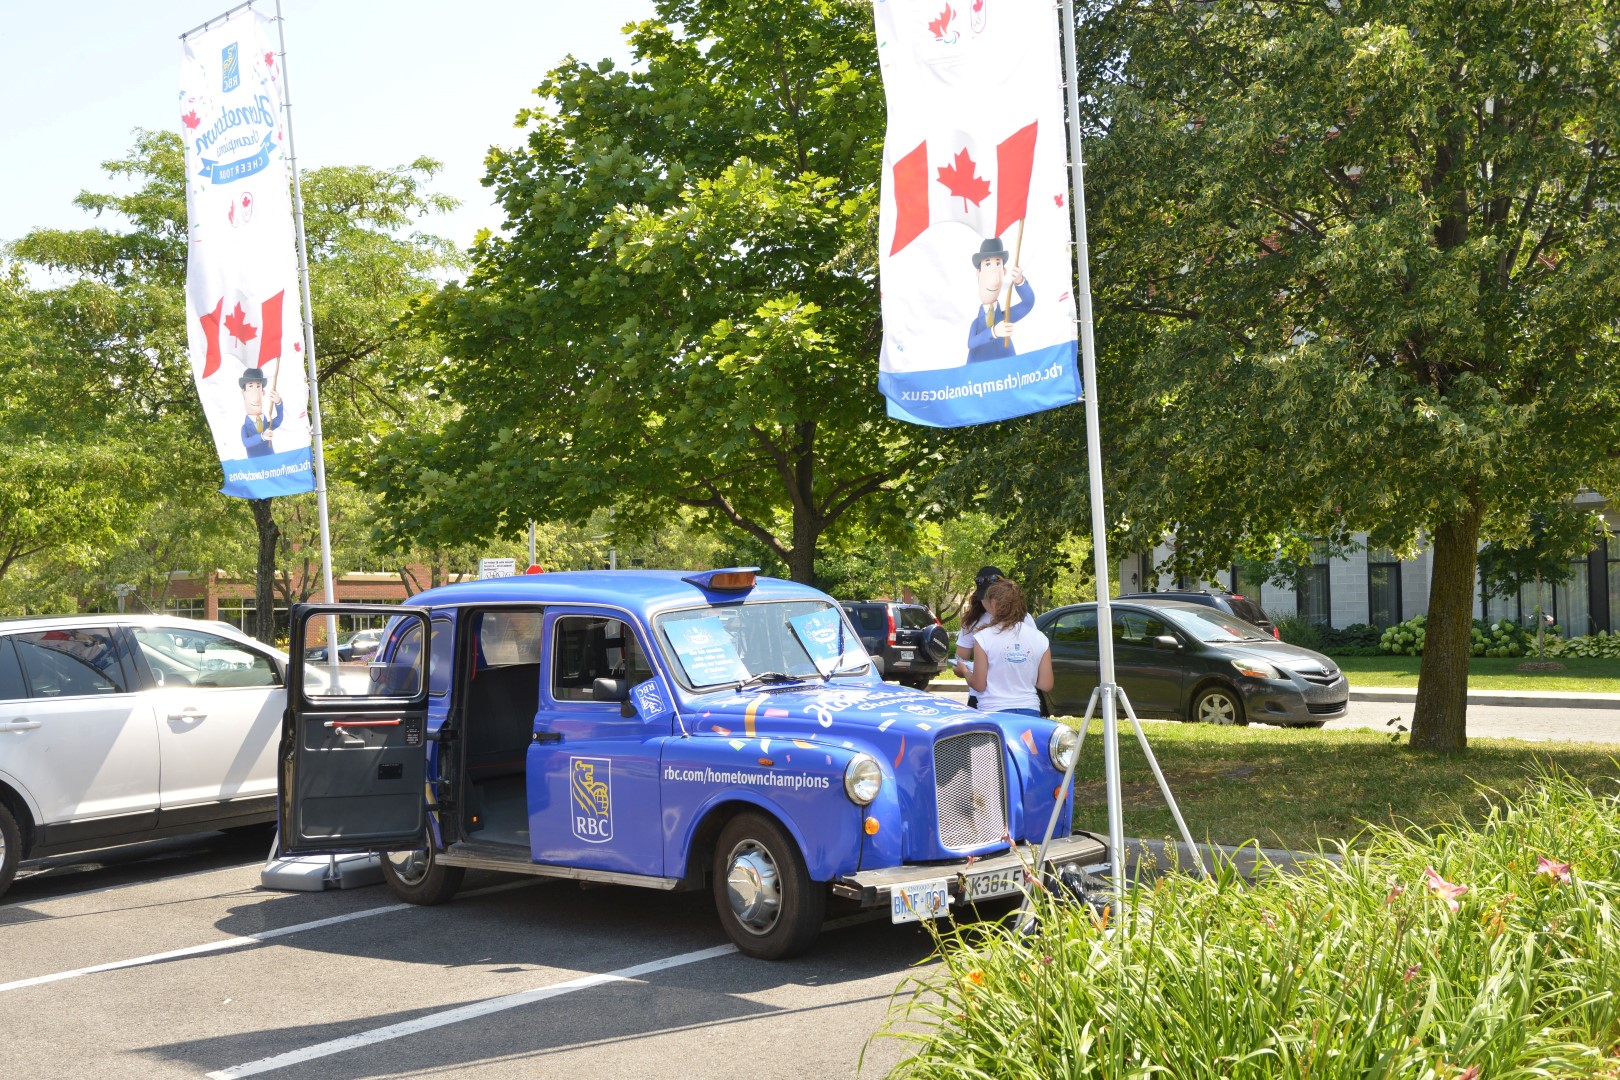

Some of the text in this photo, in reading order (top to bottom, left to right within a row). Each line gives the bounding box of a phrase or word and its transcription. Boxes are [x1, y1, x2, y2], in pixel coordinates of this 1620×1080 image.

[637, 683, 655, 697] RBC
[664, 766, 829, 790] rbc.com/hometownchampions
[576, 816, 608, 837] RBC
